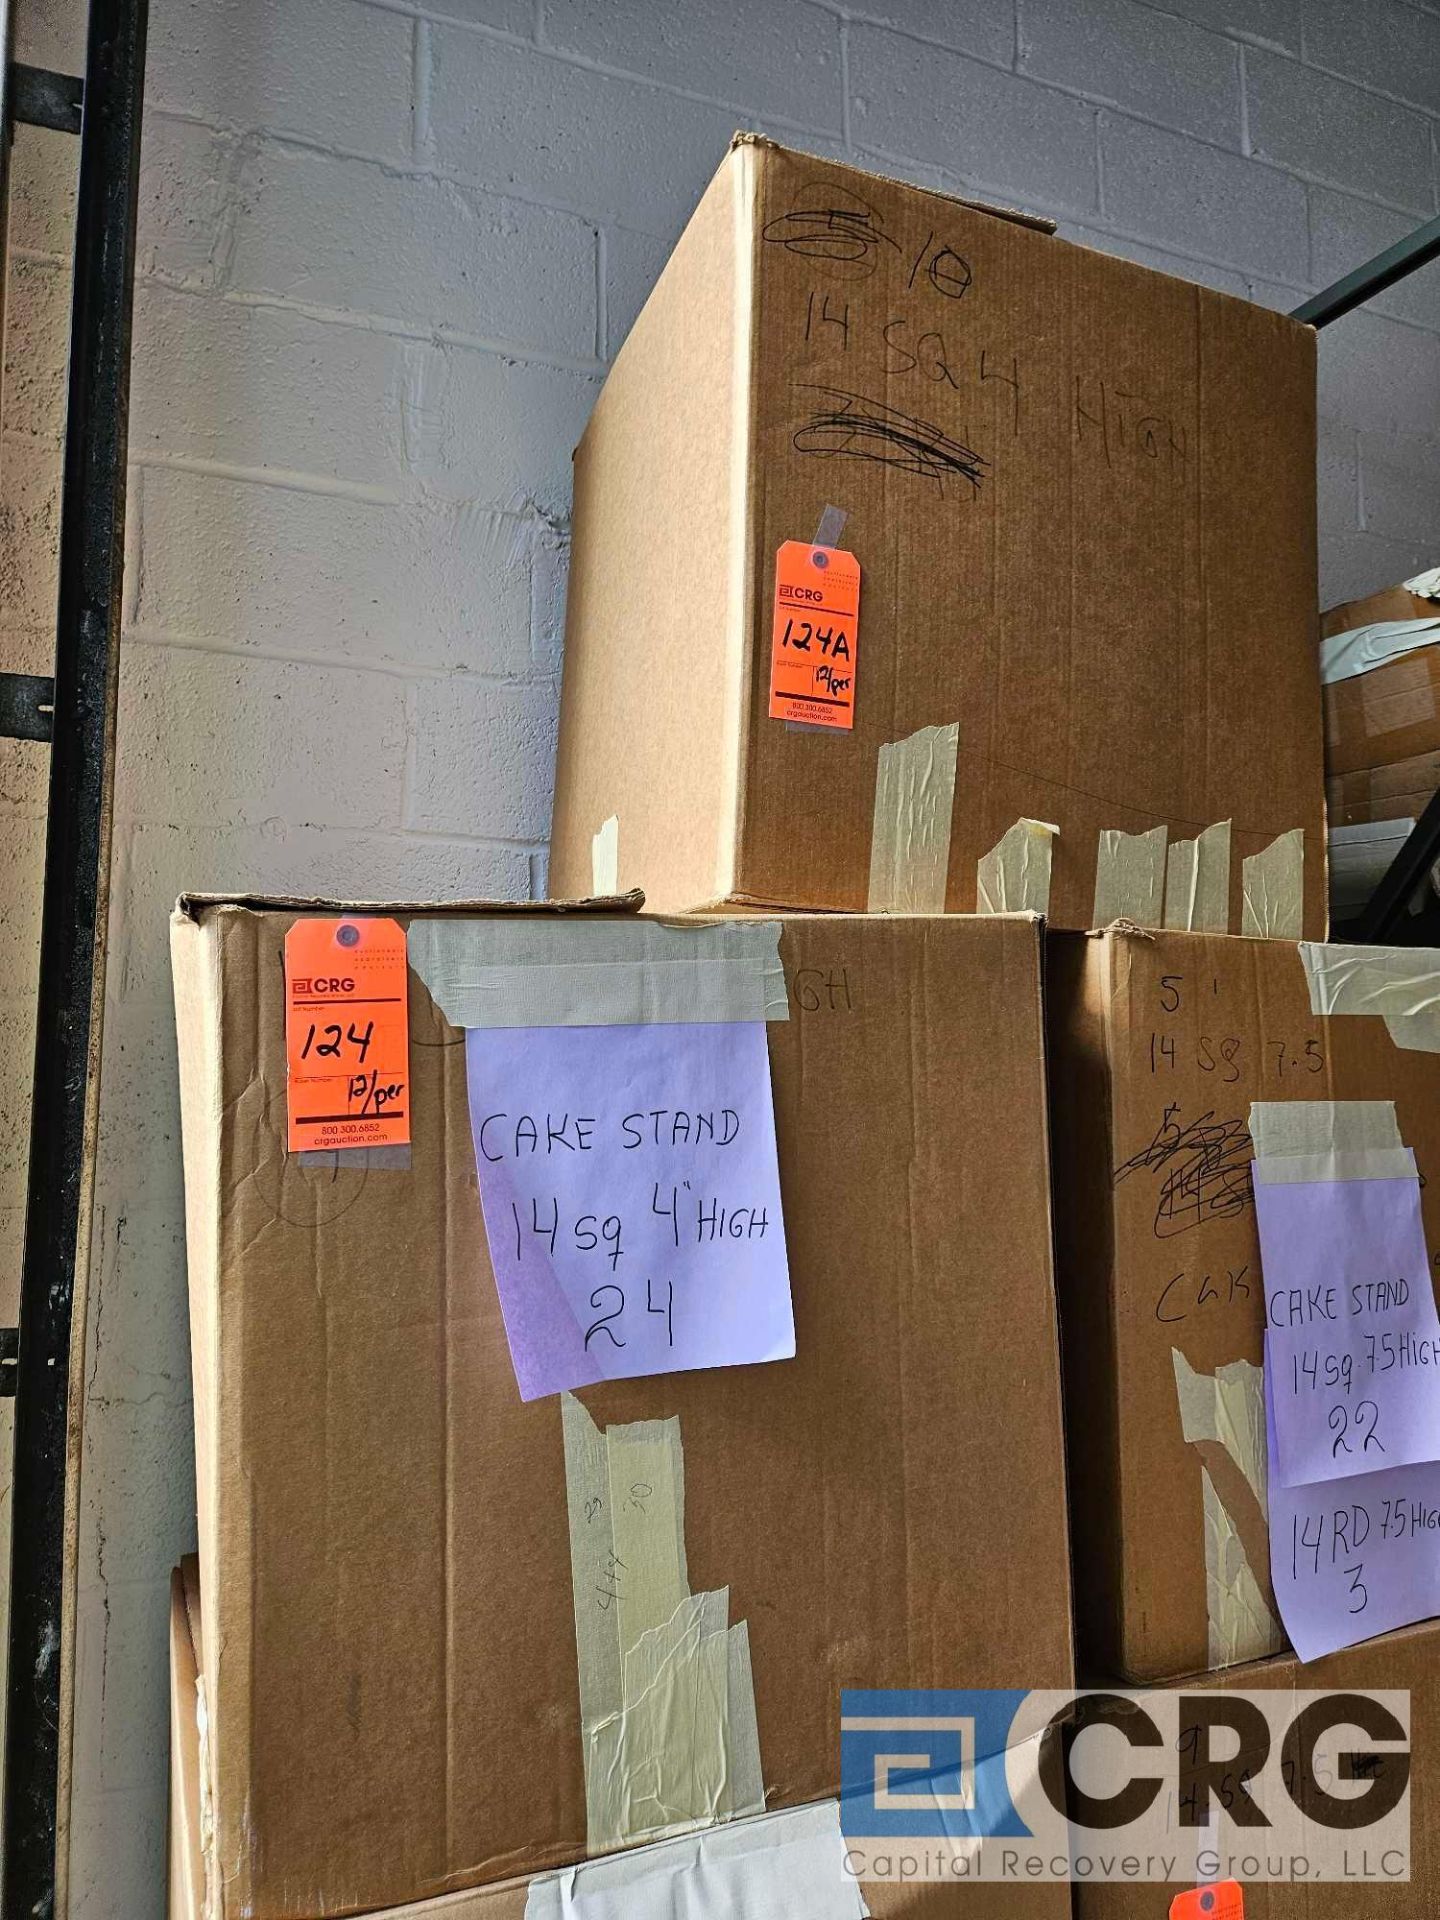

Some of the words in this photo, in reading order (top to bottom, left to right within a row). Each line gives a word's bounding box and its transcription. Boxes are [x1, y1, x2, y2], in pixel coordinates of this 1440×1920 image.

[804, 291, 849, 351] 14
[882, 320, 959, 389] SQ
[981, 350, 1019, 435] 4
[793, 586, 824, 602] CRG
[782, 618, 850, 662] 124A
[314, 977, 355, 993] CRG
[1160, 975, 1183, 1012] 5
[301, 1021, 374, 1063] 124
[1150, 1032, 1175, 1073] 14
[1266, 1040, 1324, 1077] 7.5
[314, 1133, 388, 1148] crgauction.com
[480, 1113, 596, 1162] CAKE
[622, 1109, 740, 1150] STAND
[511, 1197, 559, 1261] 14
[697, 1197, 769, 1242] HIGH
[584, 1278, 673, 1353] 24
[1270, 1282, 1337, 1328] CAKE
[1351, 1277, 1410, 1318] STAND
[1293, 1350, 1319, 1396] 14
[1327, 1400, 1386, 1459] 22
[1292, 1514, 1322, 1580] 14
[1332, 1505, 1370, 1564] RD
[1380, 1498, 1407, 1540] 7.5
[1411, 1501, 1440, 1538] HIG
[1343, 1563, 1368, 1615] 3
